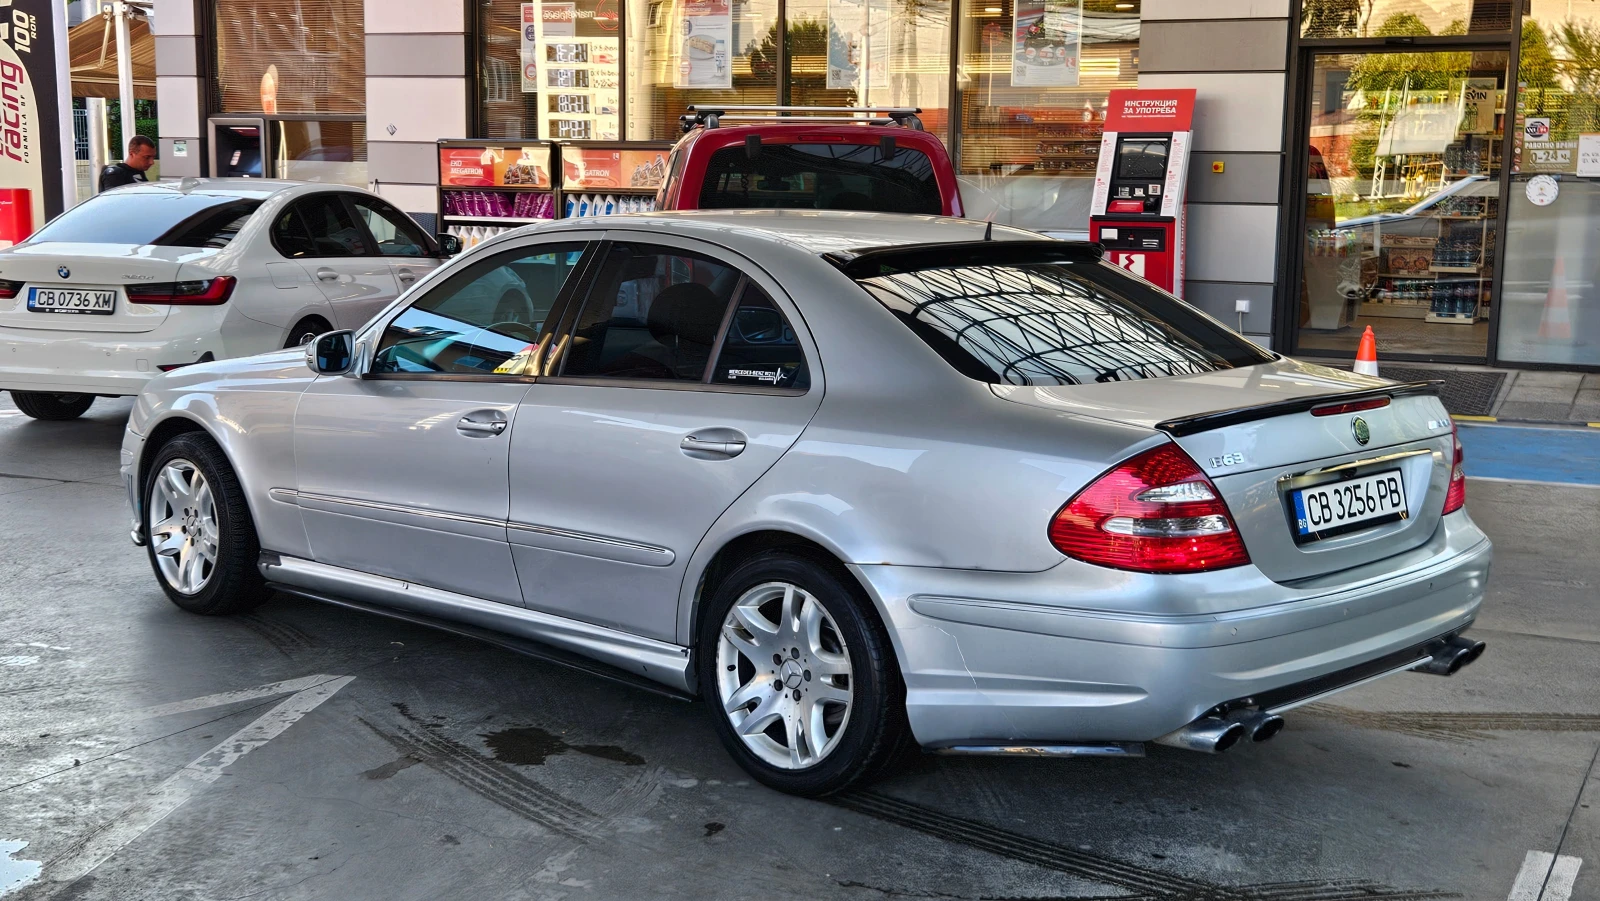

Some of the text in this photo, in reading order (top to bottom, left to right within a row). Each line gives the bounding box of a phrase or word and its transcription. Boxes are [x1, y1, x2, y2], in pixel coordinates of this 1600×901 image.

[13, 9, 31, 53] 100
[1465, 90, 1487, 100] EVIN
[0, 59, 24, 162] racing
[1124, 100, 1178, 108] ИНСТРУКЦИЯ
[22, 113, 30, 164] FORMULA
[37, 291, 112, 308] CB 0736 XM
[1209, 452, 1245, 469] E63
[1306, 476, 1402, 527] CB 3256 PB
[1298, 519, 1307, 529] BG
